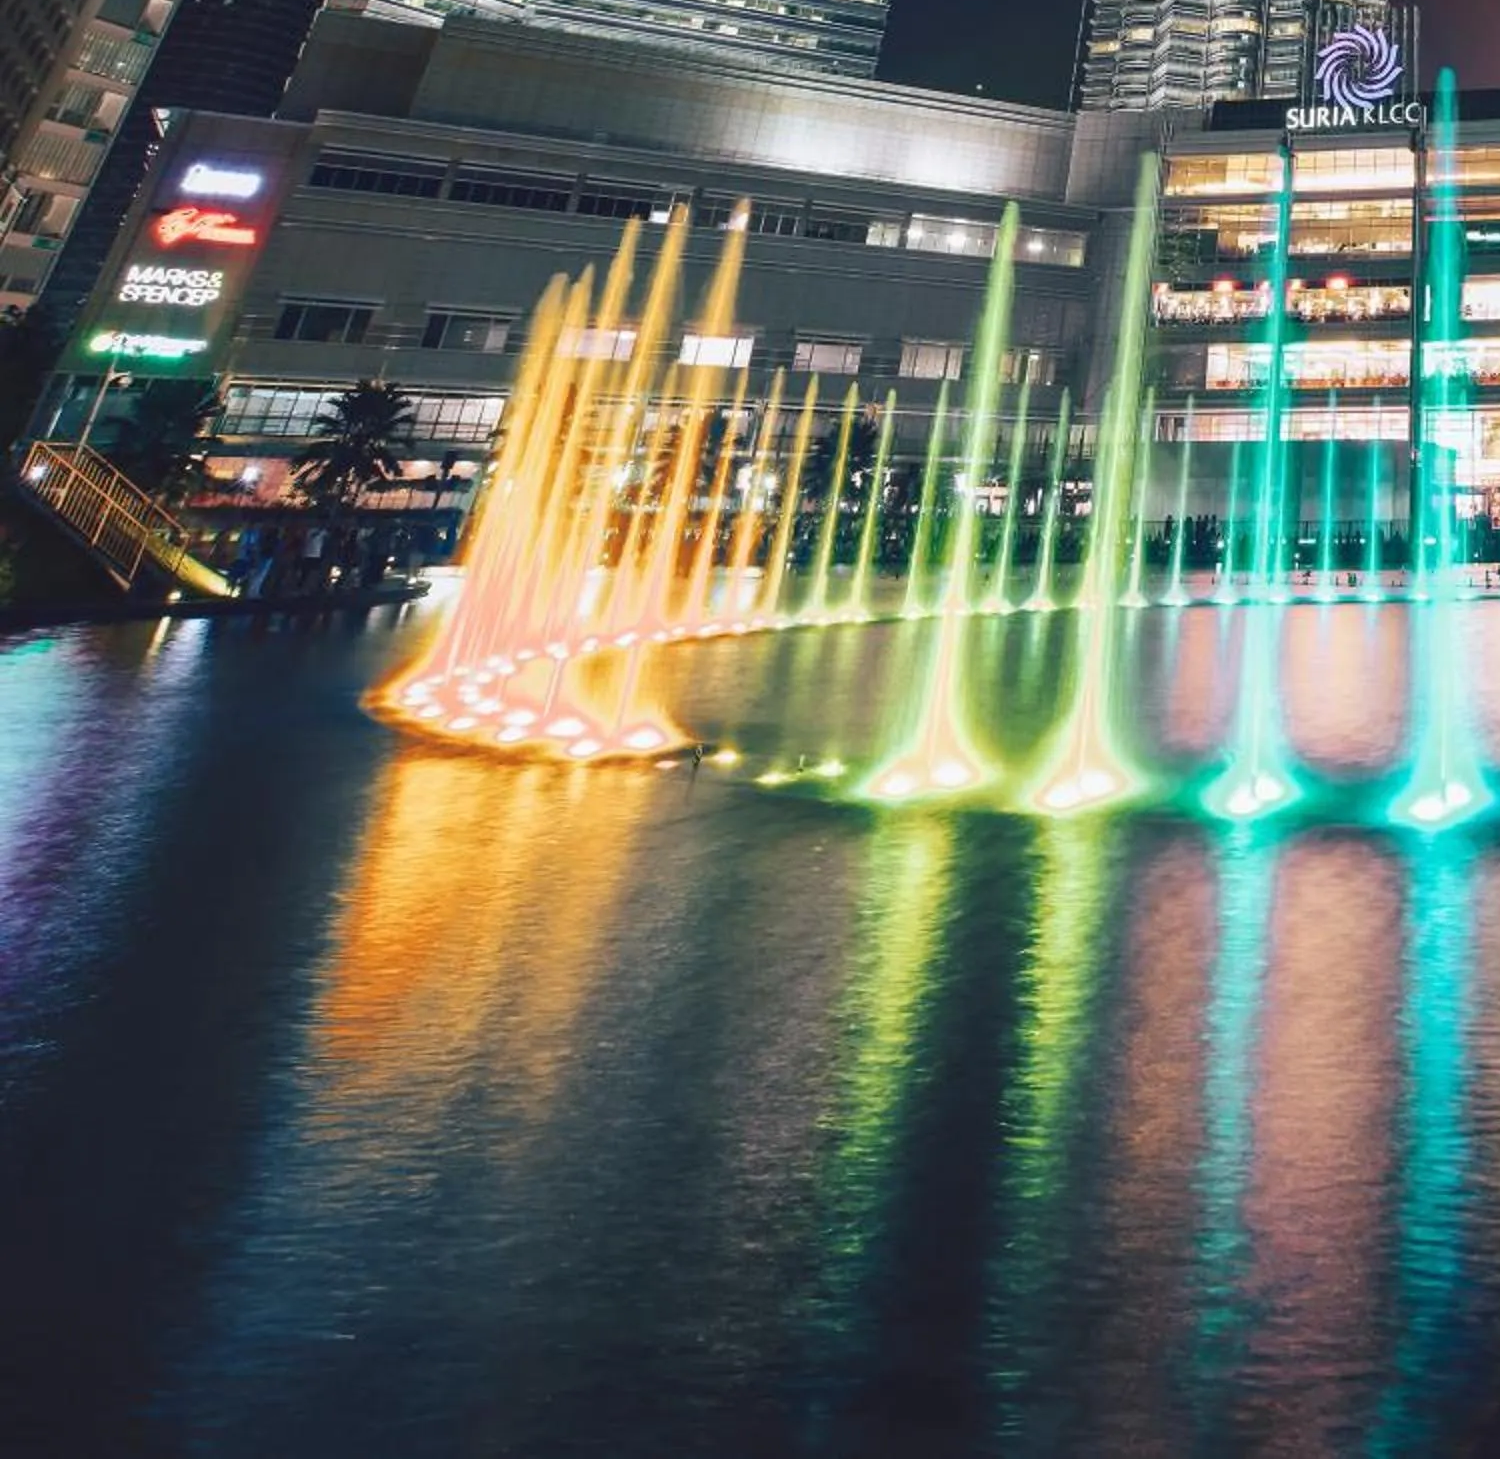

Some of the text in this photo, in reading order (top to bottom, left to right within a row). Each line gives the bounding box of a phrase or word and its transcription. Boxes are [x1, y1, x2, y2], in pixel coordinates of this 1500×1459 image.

[1285, 102, 1421, 129] SURIA KLCC
[127, 265, 223, 288] MARKS &
[119, 284, 220, 307] SPENCER
